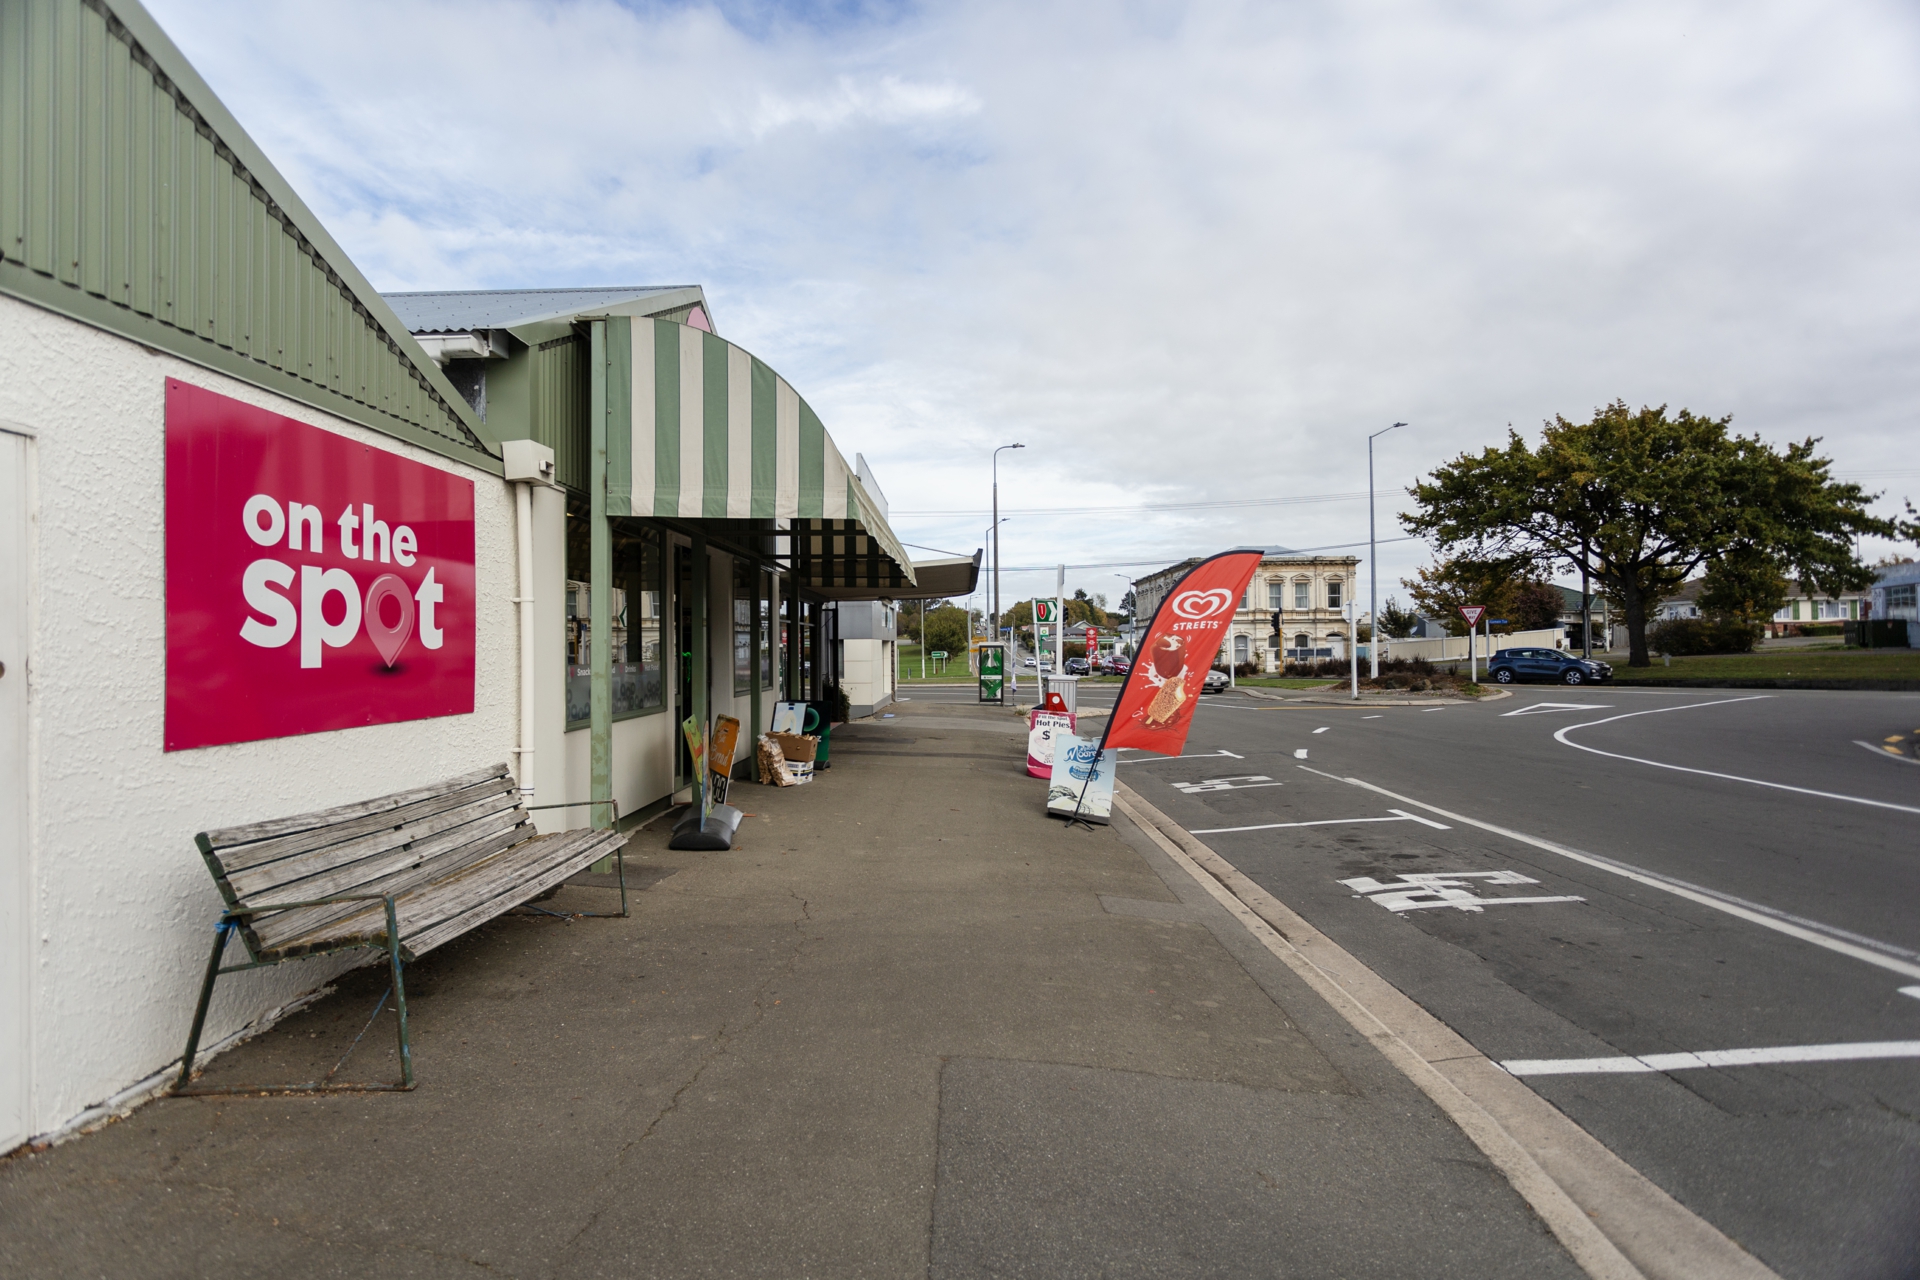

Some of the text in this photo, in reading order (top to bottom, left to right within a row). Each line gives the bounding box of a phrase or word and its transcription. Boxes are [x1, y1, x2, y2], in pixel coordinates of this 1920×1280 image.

[242, 494, 417, 567] on the
[239, 558, 444, 669] spot
[1172, 620, 1219, 631] STREETS
[577, 667, 591, 677] Snack
[625, 665, 637, 673] Drinks
[1036, 719, 1070, 729] Hot Pies
[1042, 730, 1051, 740] $
